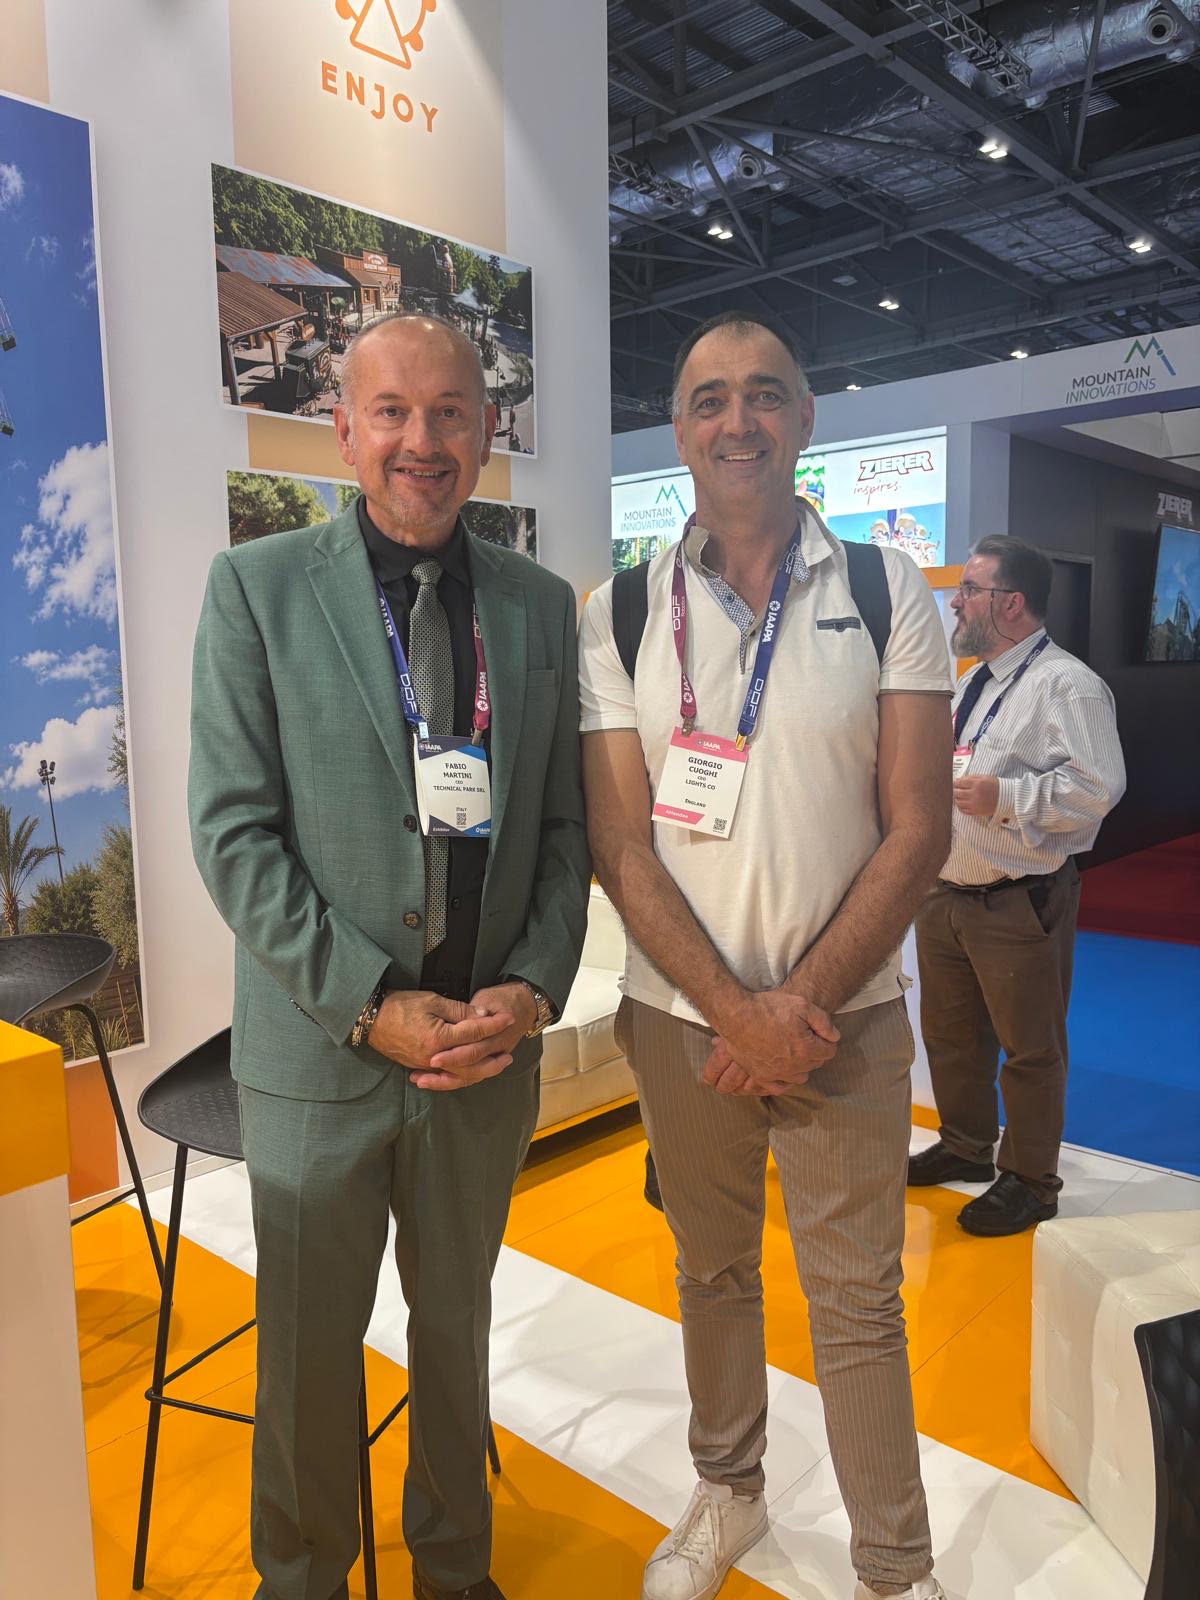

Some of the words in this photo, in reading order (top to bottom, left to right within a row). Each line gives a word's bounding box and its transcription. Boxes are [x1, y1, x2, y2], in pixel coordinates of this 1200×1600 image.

[321, 60, 438, 133] ENJOY
[1072, 365, 1150, 389] MOUNTAIN
[1065, 378, 1157, 404] INNOVATIONS
[858, 451, 934, 481] ZIERER
[624, 507, 672, 521] MOUNTAIN
[1157, 492, 1193, 521] ZIERER
[621, 517, 676, 532] INNOVATIONS
[672, 595, 681, 631] DOF
[762, 612, 778, 643] IAAPA
[400, 673, 418, 713] DOF
[479, 672, 487, 700] IAAPA
[750, 678, 764, 717] DOF
[703, 741, 721, 750] IAAPA
[444, 762, 467, 770] FABIO
[688, 756, 723, 770] GIORGIO
[688, 766, 718, 778] CUOGHI
[685, 779, 706, 788] LIGHTS
